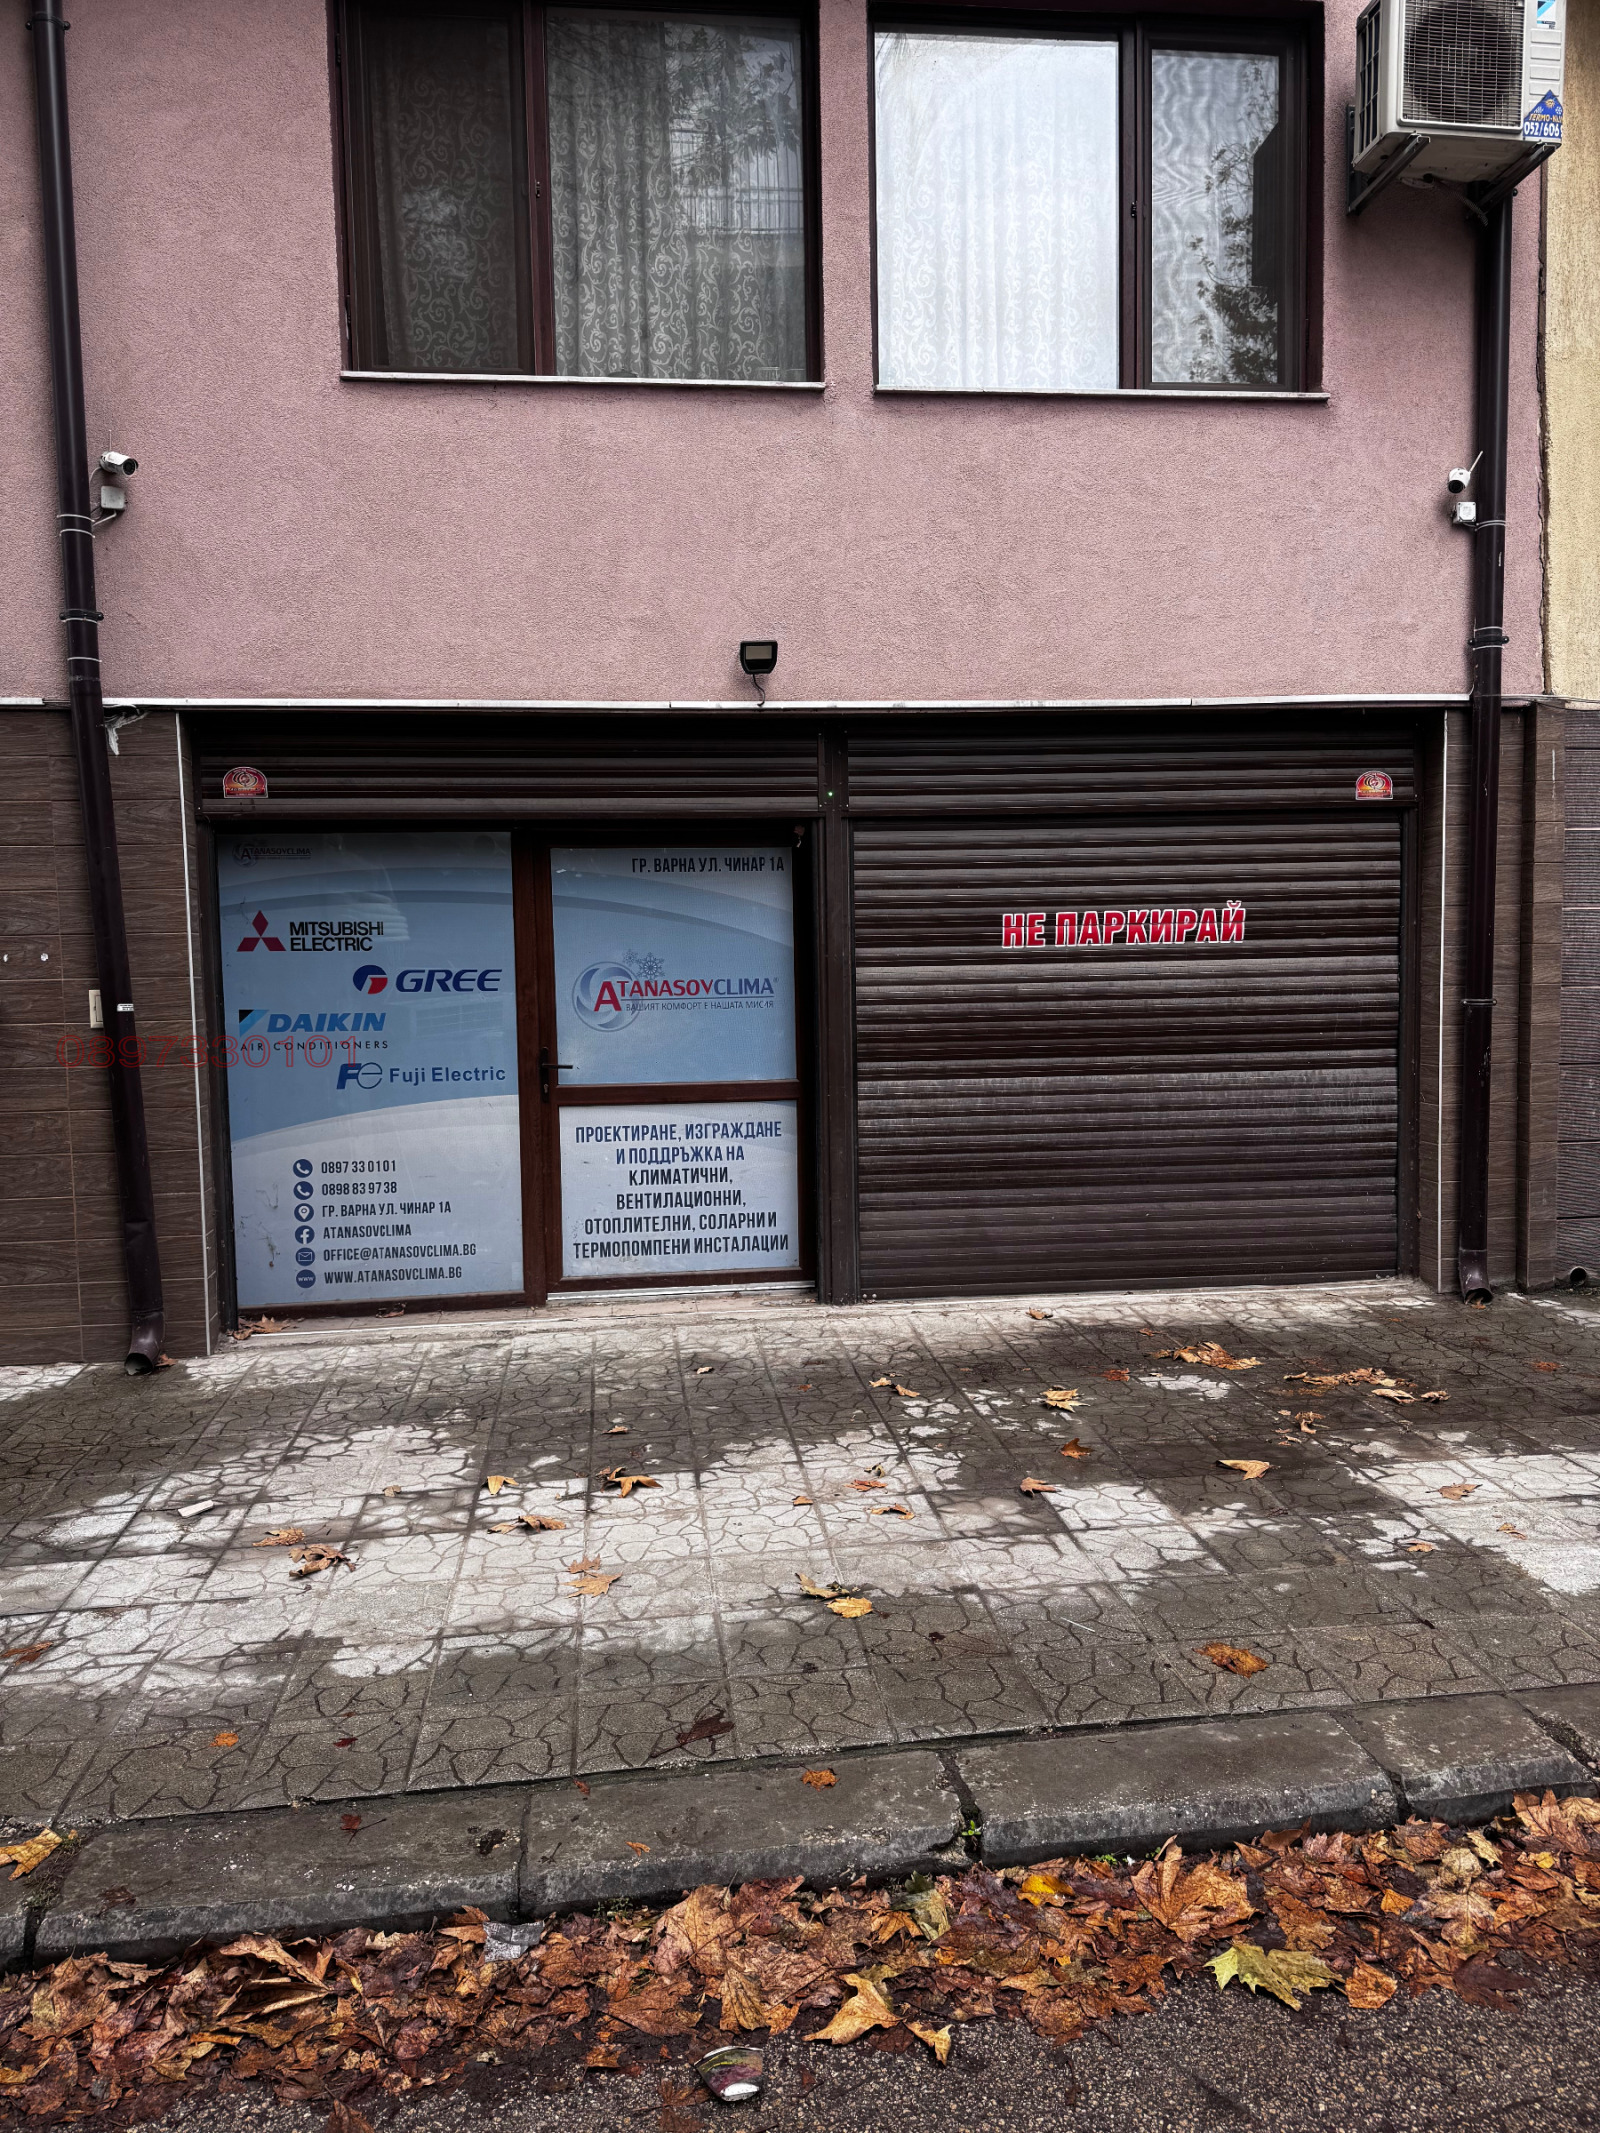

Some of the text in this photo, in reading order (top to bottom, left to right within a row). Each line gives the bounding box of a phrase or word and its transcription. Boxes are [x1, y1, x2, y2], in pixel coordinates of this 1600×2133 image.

[632, 856, 784, 873] ГР. ВАРНА УЛ. ЧИНАР 1А
[290, 921, 384, 936] MITSUBISHI
[1002, 900, 1246, 948] НЕ ПАРКИРАЙ
[290, 937, 373, 952] ELECTRIC
[395, 969, 503, 992] GREE
[662, 1001, 702, 1011] КОМФОРТ
[711, 1001, 744, 1010] НАШАТА
[267, 1012, 386, 1033] DAIKIN
[240, 1040, 388, 1051] AIR CONDITIONERS
[389, 1066, 506, 1086] Fuji Electric
[575, 1121, 782, 1143] ПРОЕКТИРАНЕ, ИЗГРАЖДАНЕ
[616, 1146, 745, 1165] И ПОДДРЪЖКА НА
[321, 1161, 349, 1174] 0897
[351, 1160, 365, 1173] 33
[629, 1167, 733, 1187] КЛИМАТИЧНИ,
[322, 1183, 350, 1196] 0898
[352, 1182, 366, 1195] 83
[322, 1205, 338, 1218] ГР.
[341, 1203, 377, 1217] ВАРНА
[379, 1202, 398, 1216] УЛ.
[400, 1201, 435, 1214] ЧИНАР
[616, 1190, 747, 1210] ВЕНТИЛАЦИОННИ,
[323, 1224, 412, 1240] ATANASOVCLIMA
[584, 1211, 777, 1235] ОТОПЛИТЕЛНИ, СОЛАРНИ И
[323, 1243, 477, 1262] OFFICE@ATANASOVCLIMA.BG
[573, 1234, 789, 1259] ТЕРМОПОМПЕНИ ИНСТАЛАЦИИ
[324, 1266, 462, 1285] WWW.ATANASOVCLIMA.BG
